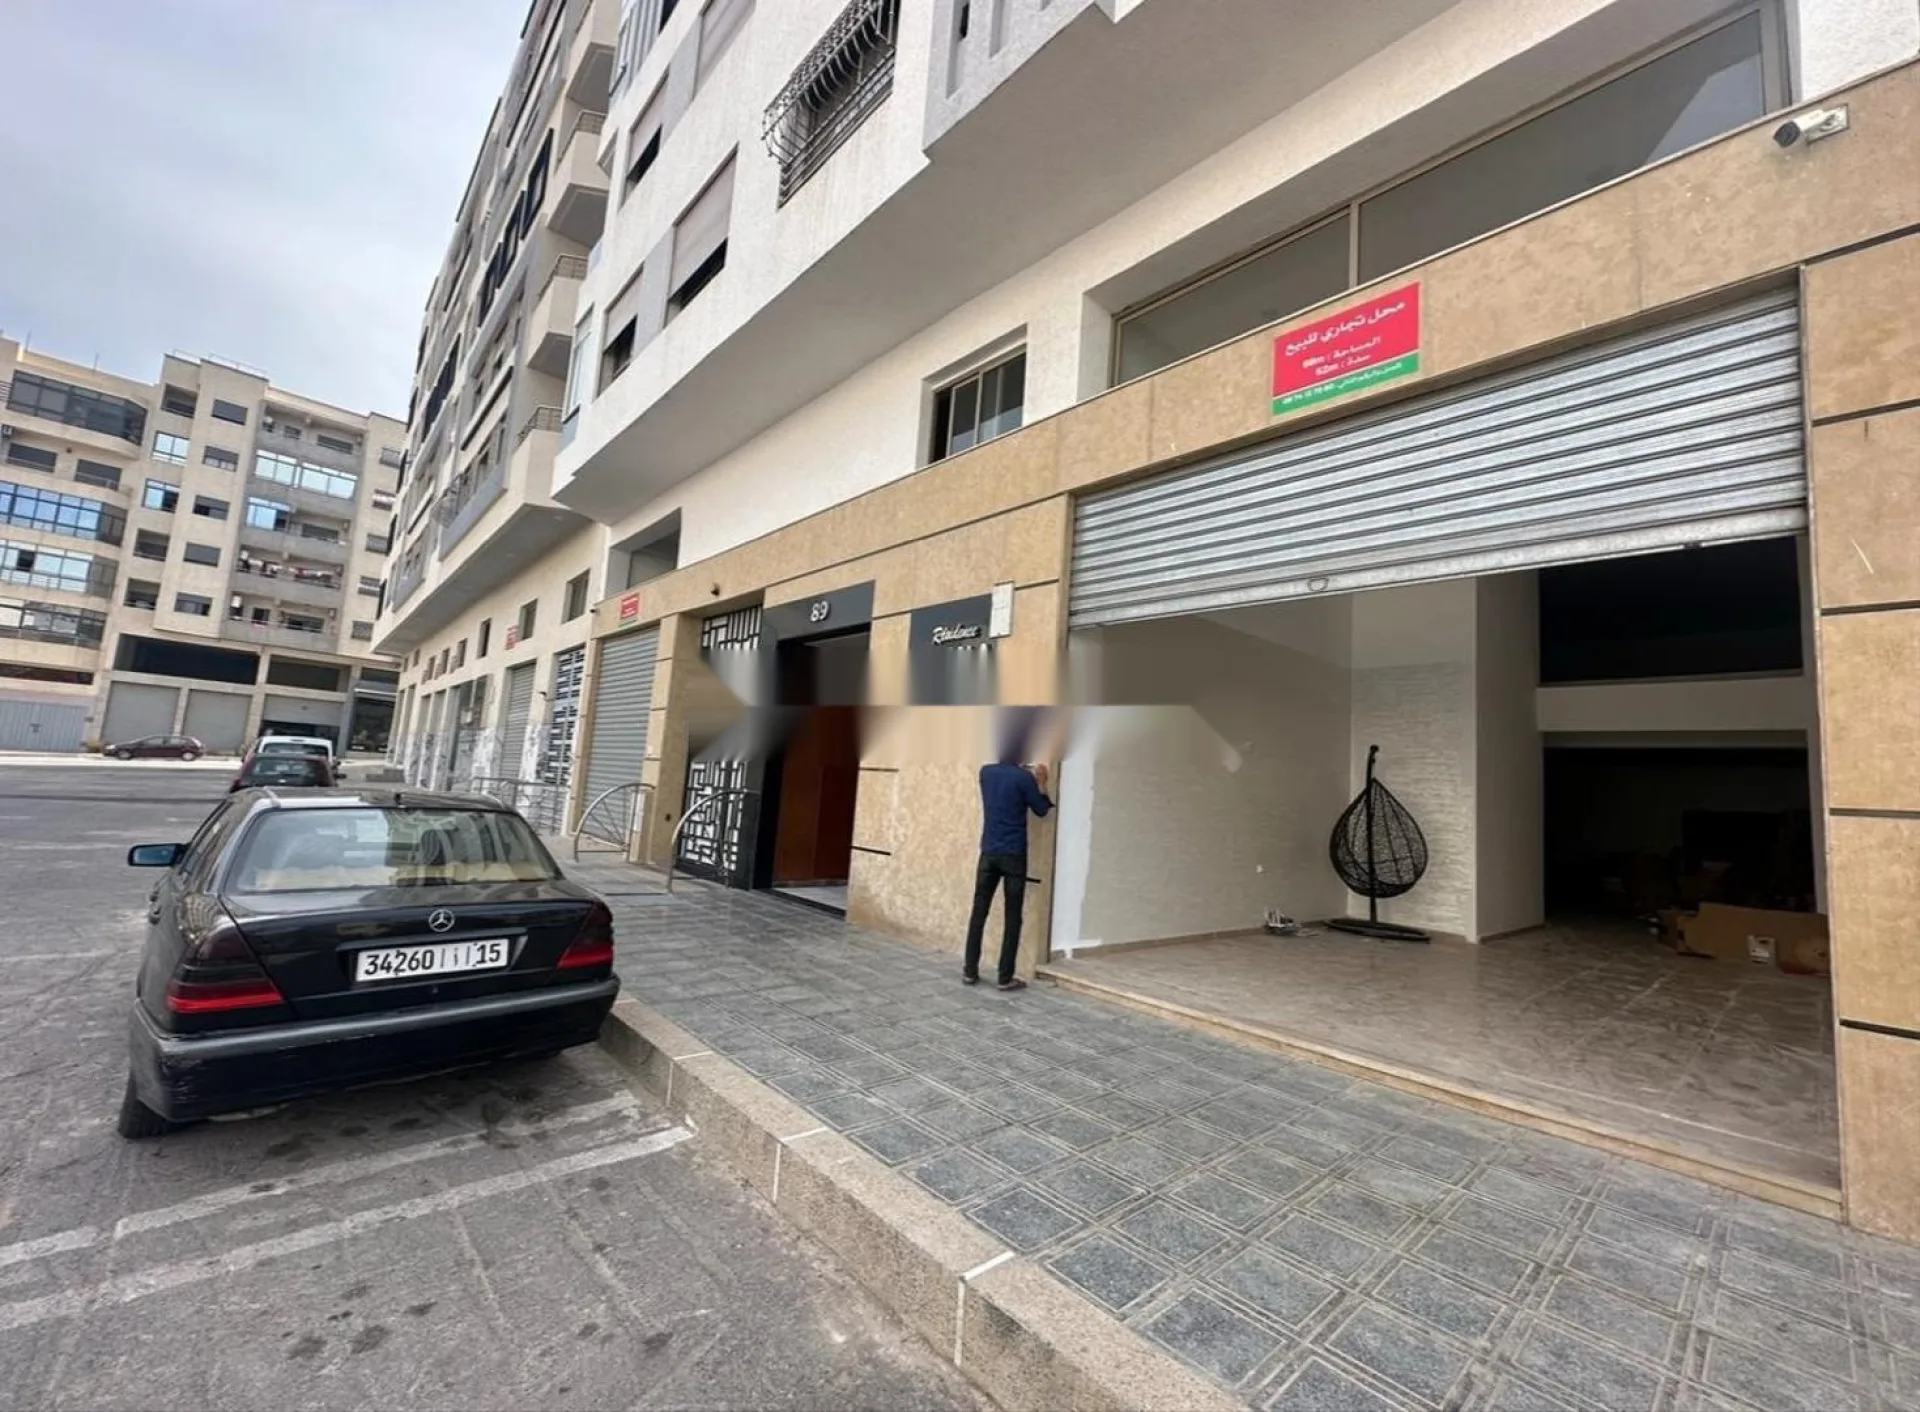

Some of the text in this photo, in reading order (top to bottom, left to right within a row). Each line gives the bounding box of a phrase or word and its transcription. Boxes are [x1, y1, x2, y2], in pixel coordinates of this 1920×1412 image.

[1286, 302, 1405, 357] محل تجاري للبيع
[810, 601, 829, 622] 89
[364, 949, 435, 975] 34260
